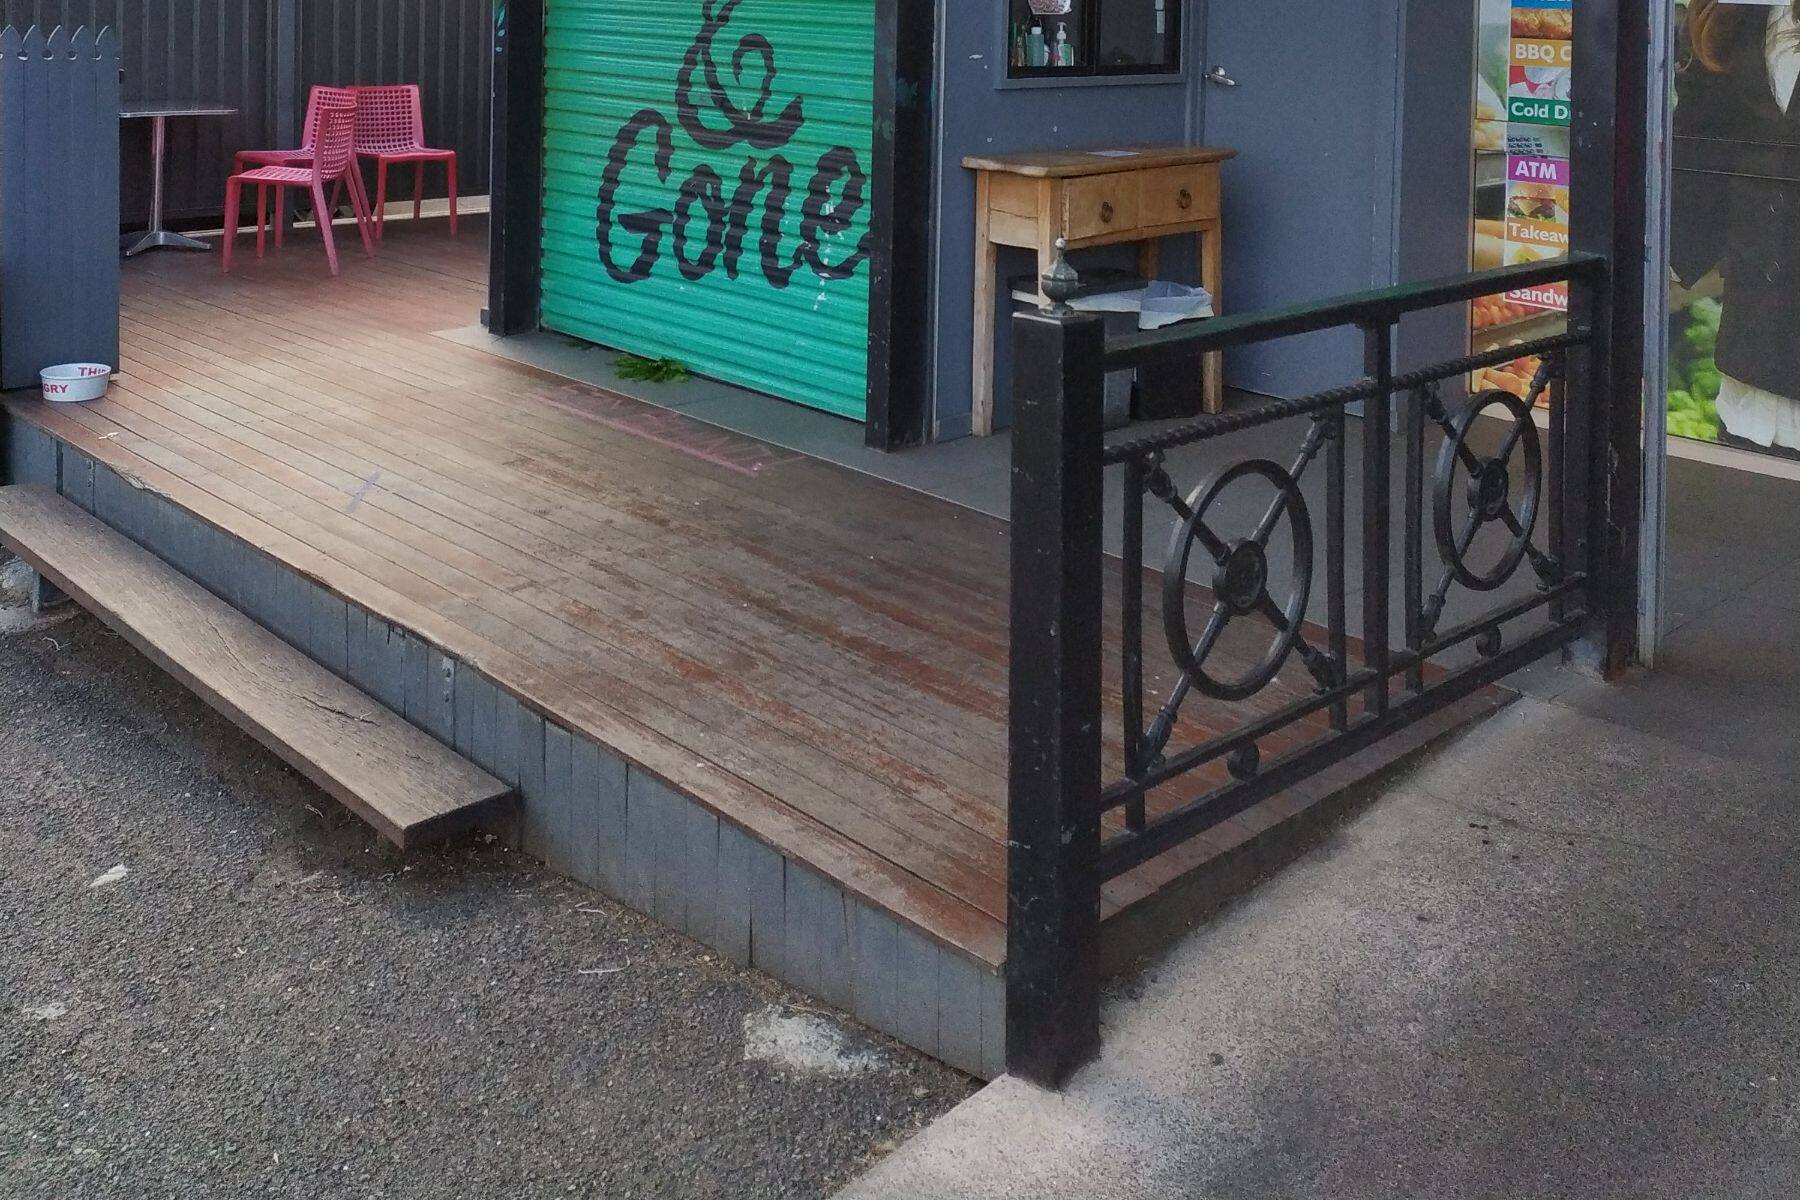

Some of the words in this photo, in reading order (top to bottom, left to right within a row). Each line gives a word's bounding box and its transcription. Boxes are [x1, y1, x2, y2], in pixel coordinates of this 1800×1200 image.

[1515, 43, 1555, 64] BBQ
[1511, 102, 1549, 119] Cold
[1515, 160, 1557, 180] ATM
[597, 110, 871, 289] Gone
[1508, 222, 1569, 244] Takeaw
[1509, 288, 1568, 306] Sandw
[42, 383, 69, 394] GRY
